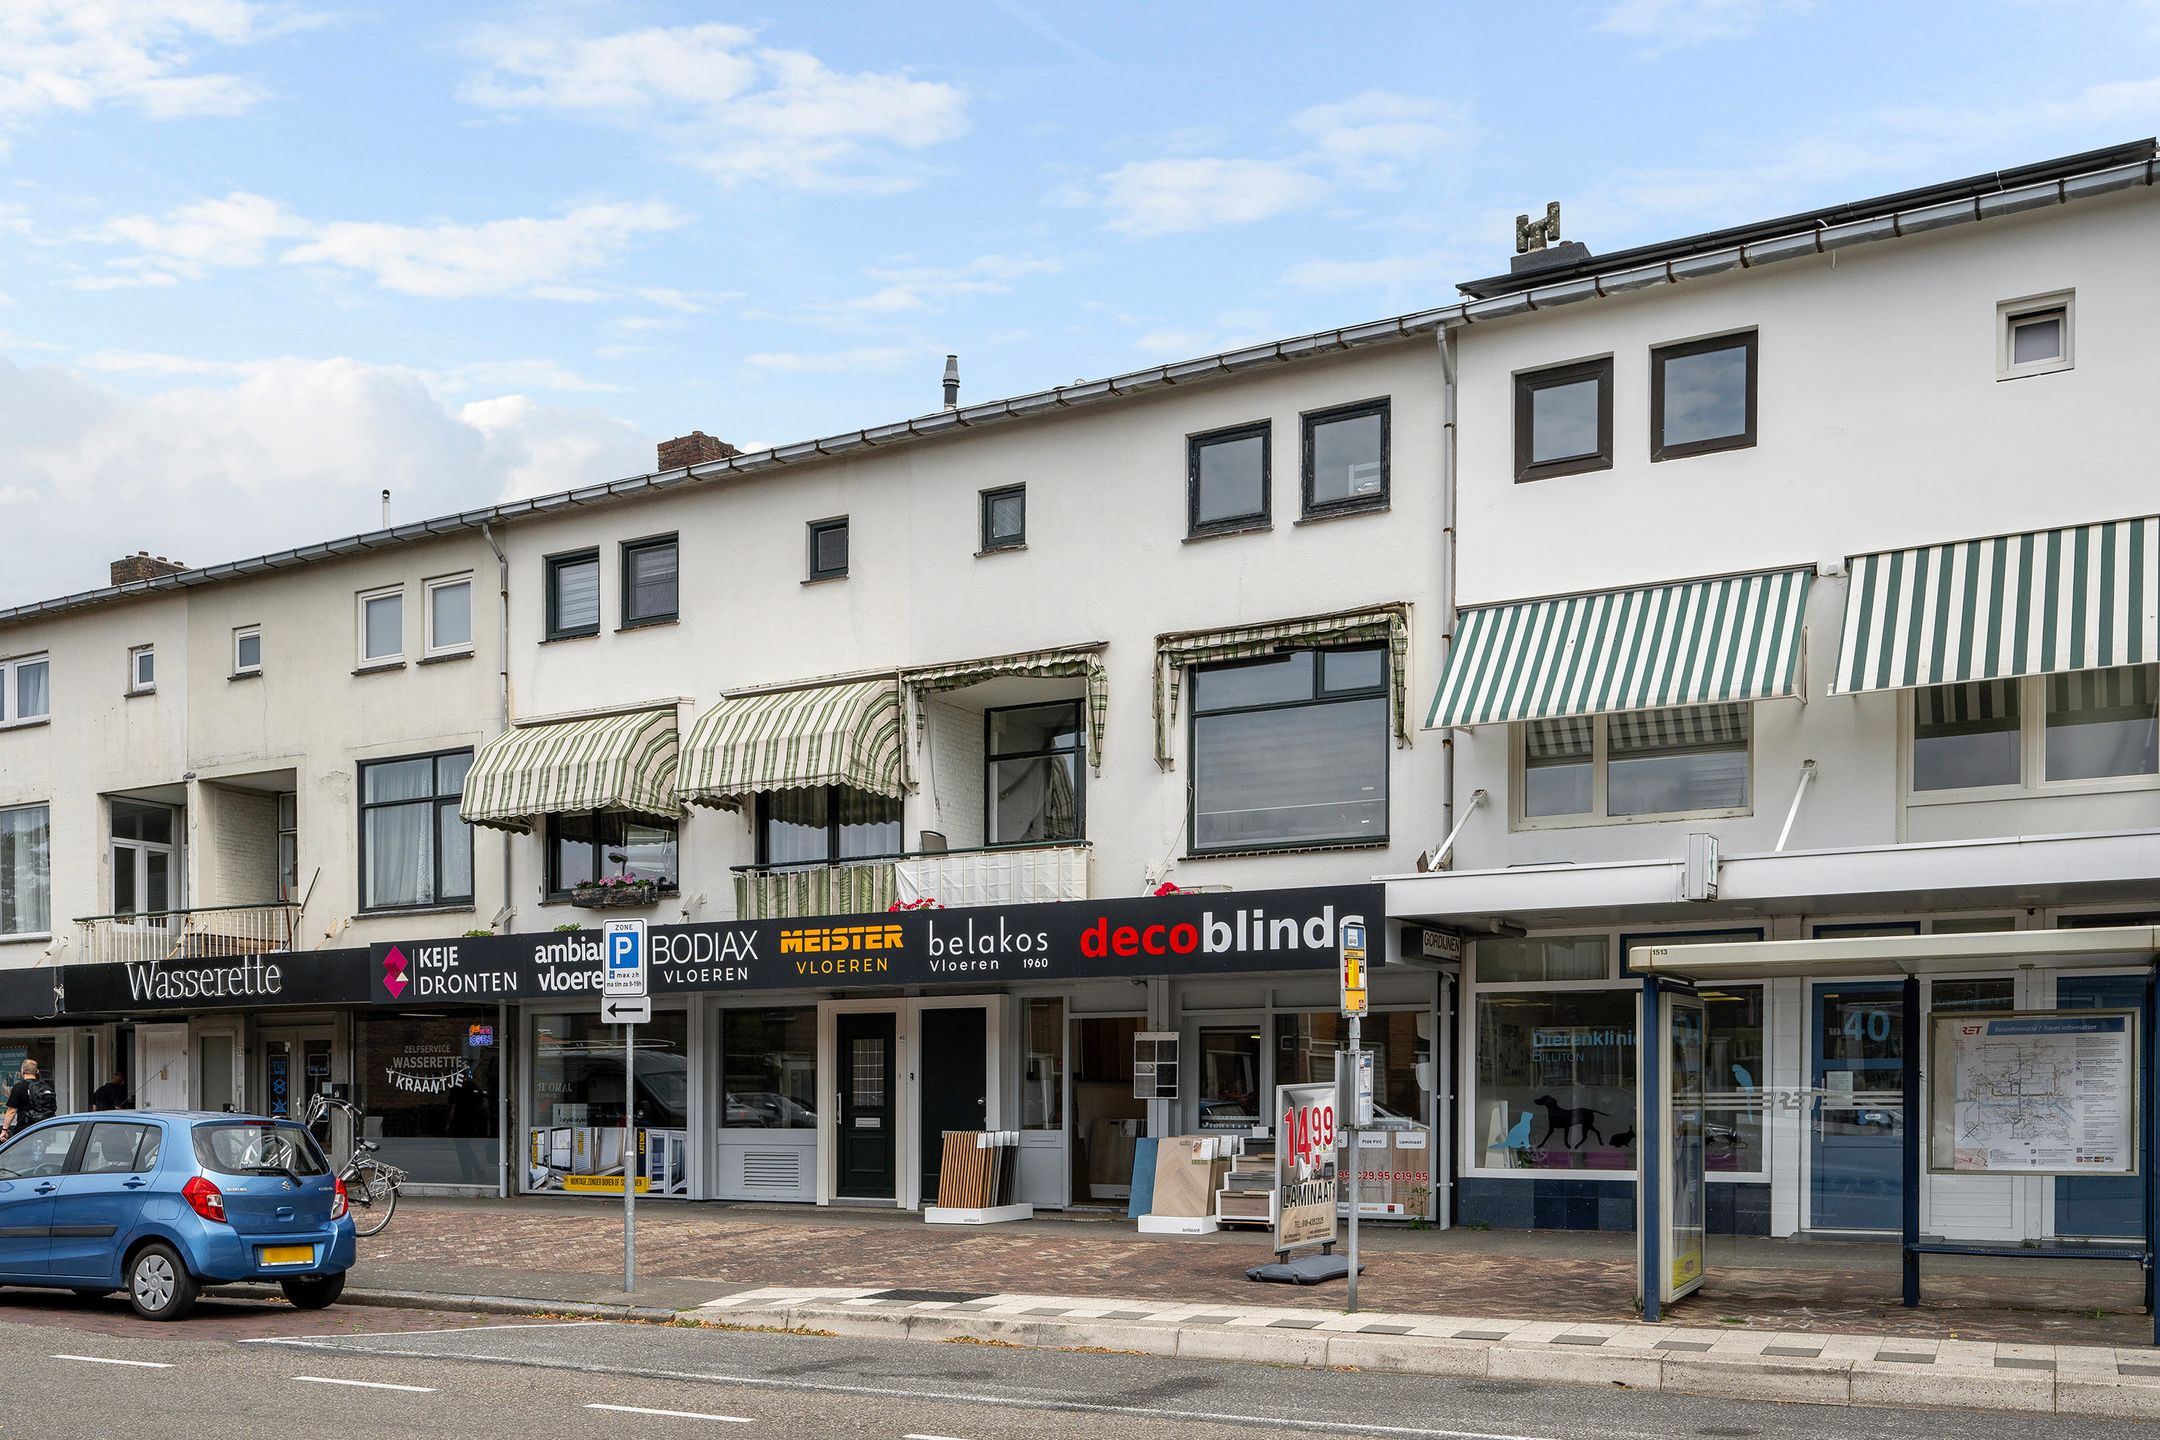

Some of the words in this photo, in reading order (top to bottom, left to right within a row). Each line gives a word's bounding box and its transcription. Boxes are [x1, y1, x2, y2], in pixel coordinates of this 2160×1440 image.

[780, 924, 905, 954] MEISTER
[929, 916, 1049, 957] belakos
[1079, 905, 1364, 958] decoblind
[1424, 931, 1460, 952] GORDIJNEN
[419, 946, 459, 974] KEJE
[534, 936, 604, 964] ambia
[615, 936, 632, 965] P
[653, 930, 759, 965] BODIAX
[125, 954, 283, 1001] Wasserette
[663, 966, 749, 984] VLOEREN
[796, 957, 889, 975] VLOEREN
[930, 958, 999, 972] Vloeren
[1023, 957, 1049, 969] 1960
[420, 971, 518, 996] DRONTEN
[538, 964, 604, 992] vloere
[1533, 1030, 1637, 1047] Dierenklini
[1844, 1009, 1891, 1042] 40
[1961, 1026, 1983, 1035] RET
[2043, 1024, 2062, 1032] Travel
[2063, 1023, 2097, 1031] information
[404, 1044, 451, 1054] ZELFSERVICE
[393, 1056, 462, 1069] WASSERETTE
[395, 1073, 465, 1094] KRAANTJE
[1394, 1172, 1428, 1182] €19,95
[1282, 1181, 1333, 1209] LAMINAAT
